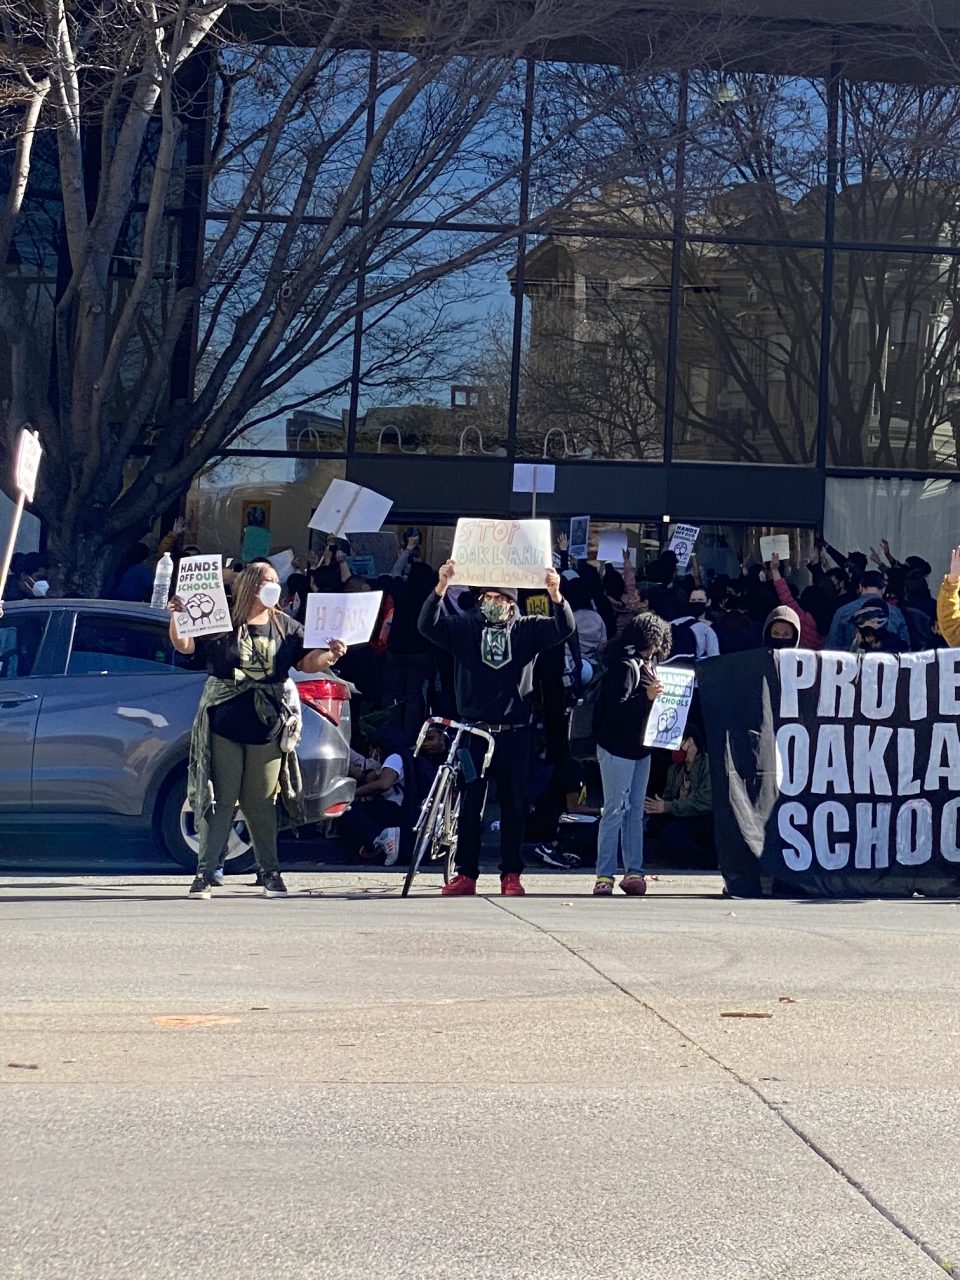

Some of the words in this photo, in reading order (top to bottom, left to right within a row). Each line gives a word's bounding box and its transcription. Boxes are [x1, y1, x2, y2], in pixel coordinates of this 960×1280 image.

[459, 520, 521, 545] STOP
[677, 525, 698, 534] HANDS
[456, 544, 545, 566] OAKLAND
[180, 561, 219, 573] HANDS
[179, 573, 194, 582] OFF
[195, 572, 219, 581] OUR
[177, 582, 221, 592] SCHOOLS
[657, 672, 692, 687] HANDS
[656, 695, 689, 707] SCHOOLS
